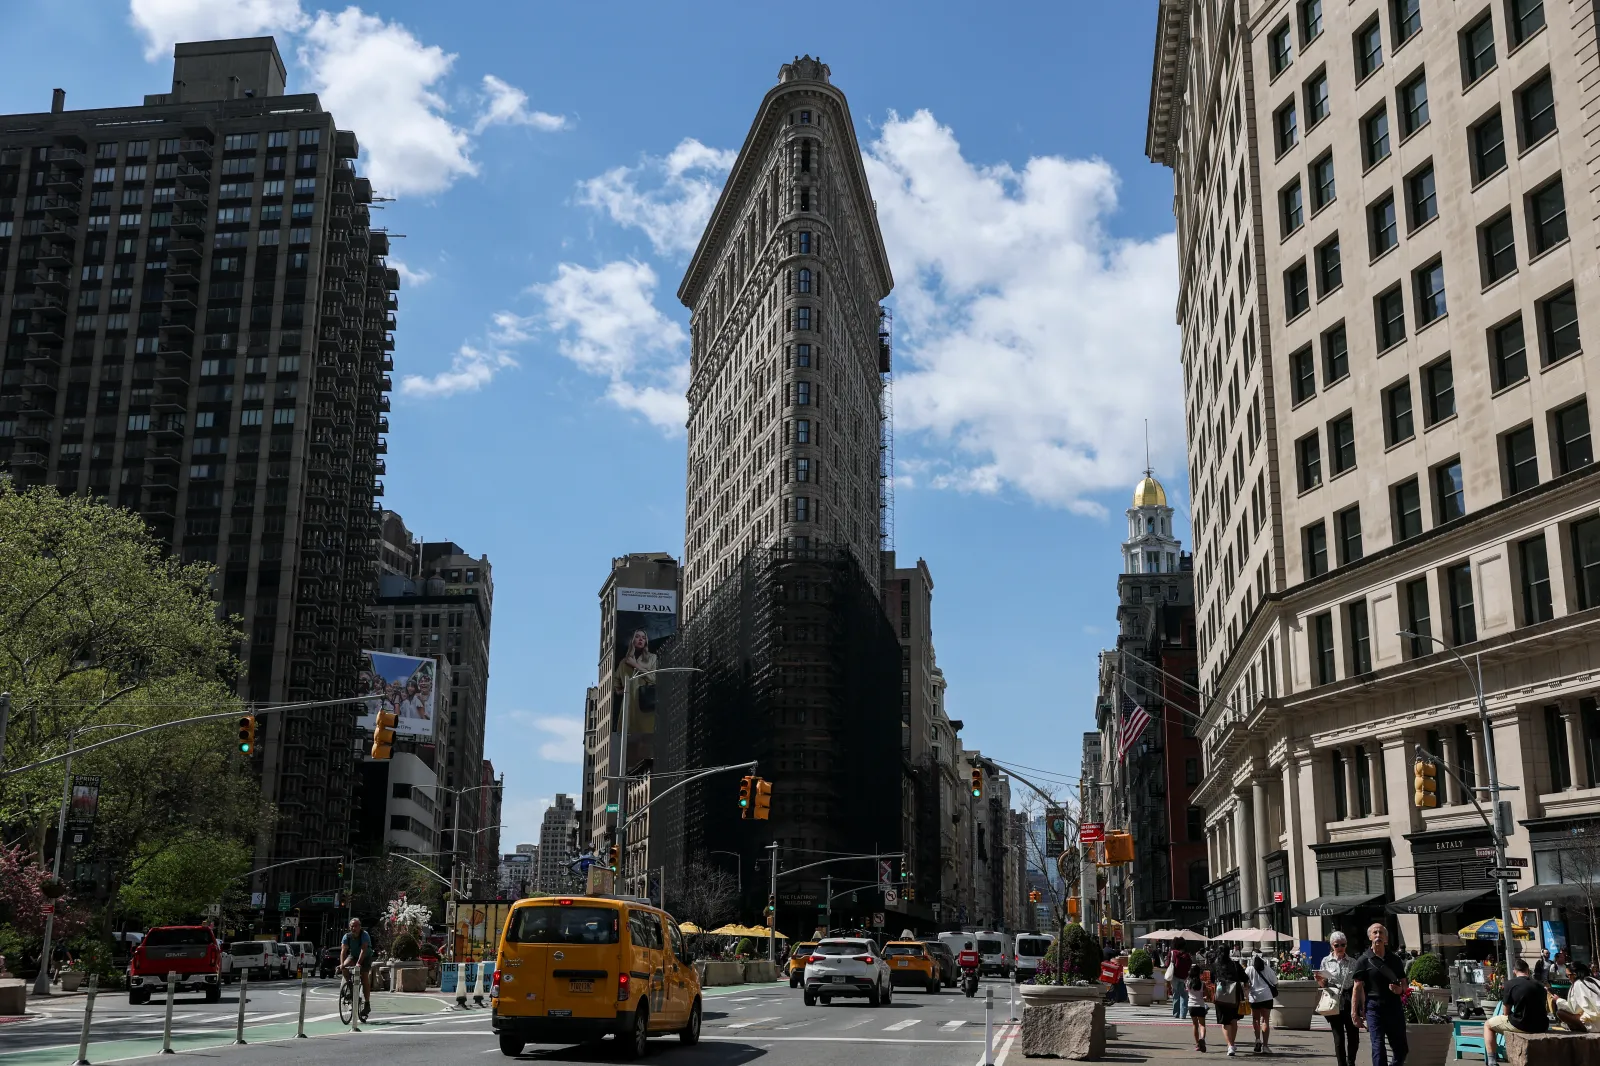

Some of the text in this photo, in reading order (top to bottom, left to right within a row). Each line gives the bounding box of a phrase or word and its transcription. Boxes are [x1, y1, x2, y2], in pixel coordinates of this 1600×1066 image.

[638, 604, 671, 612] PRADA
[1436, 840, 1464, 850] EATALY
[1335, 850, 1359, 858] ITALIAN
